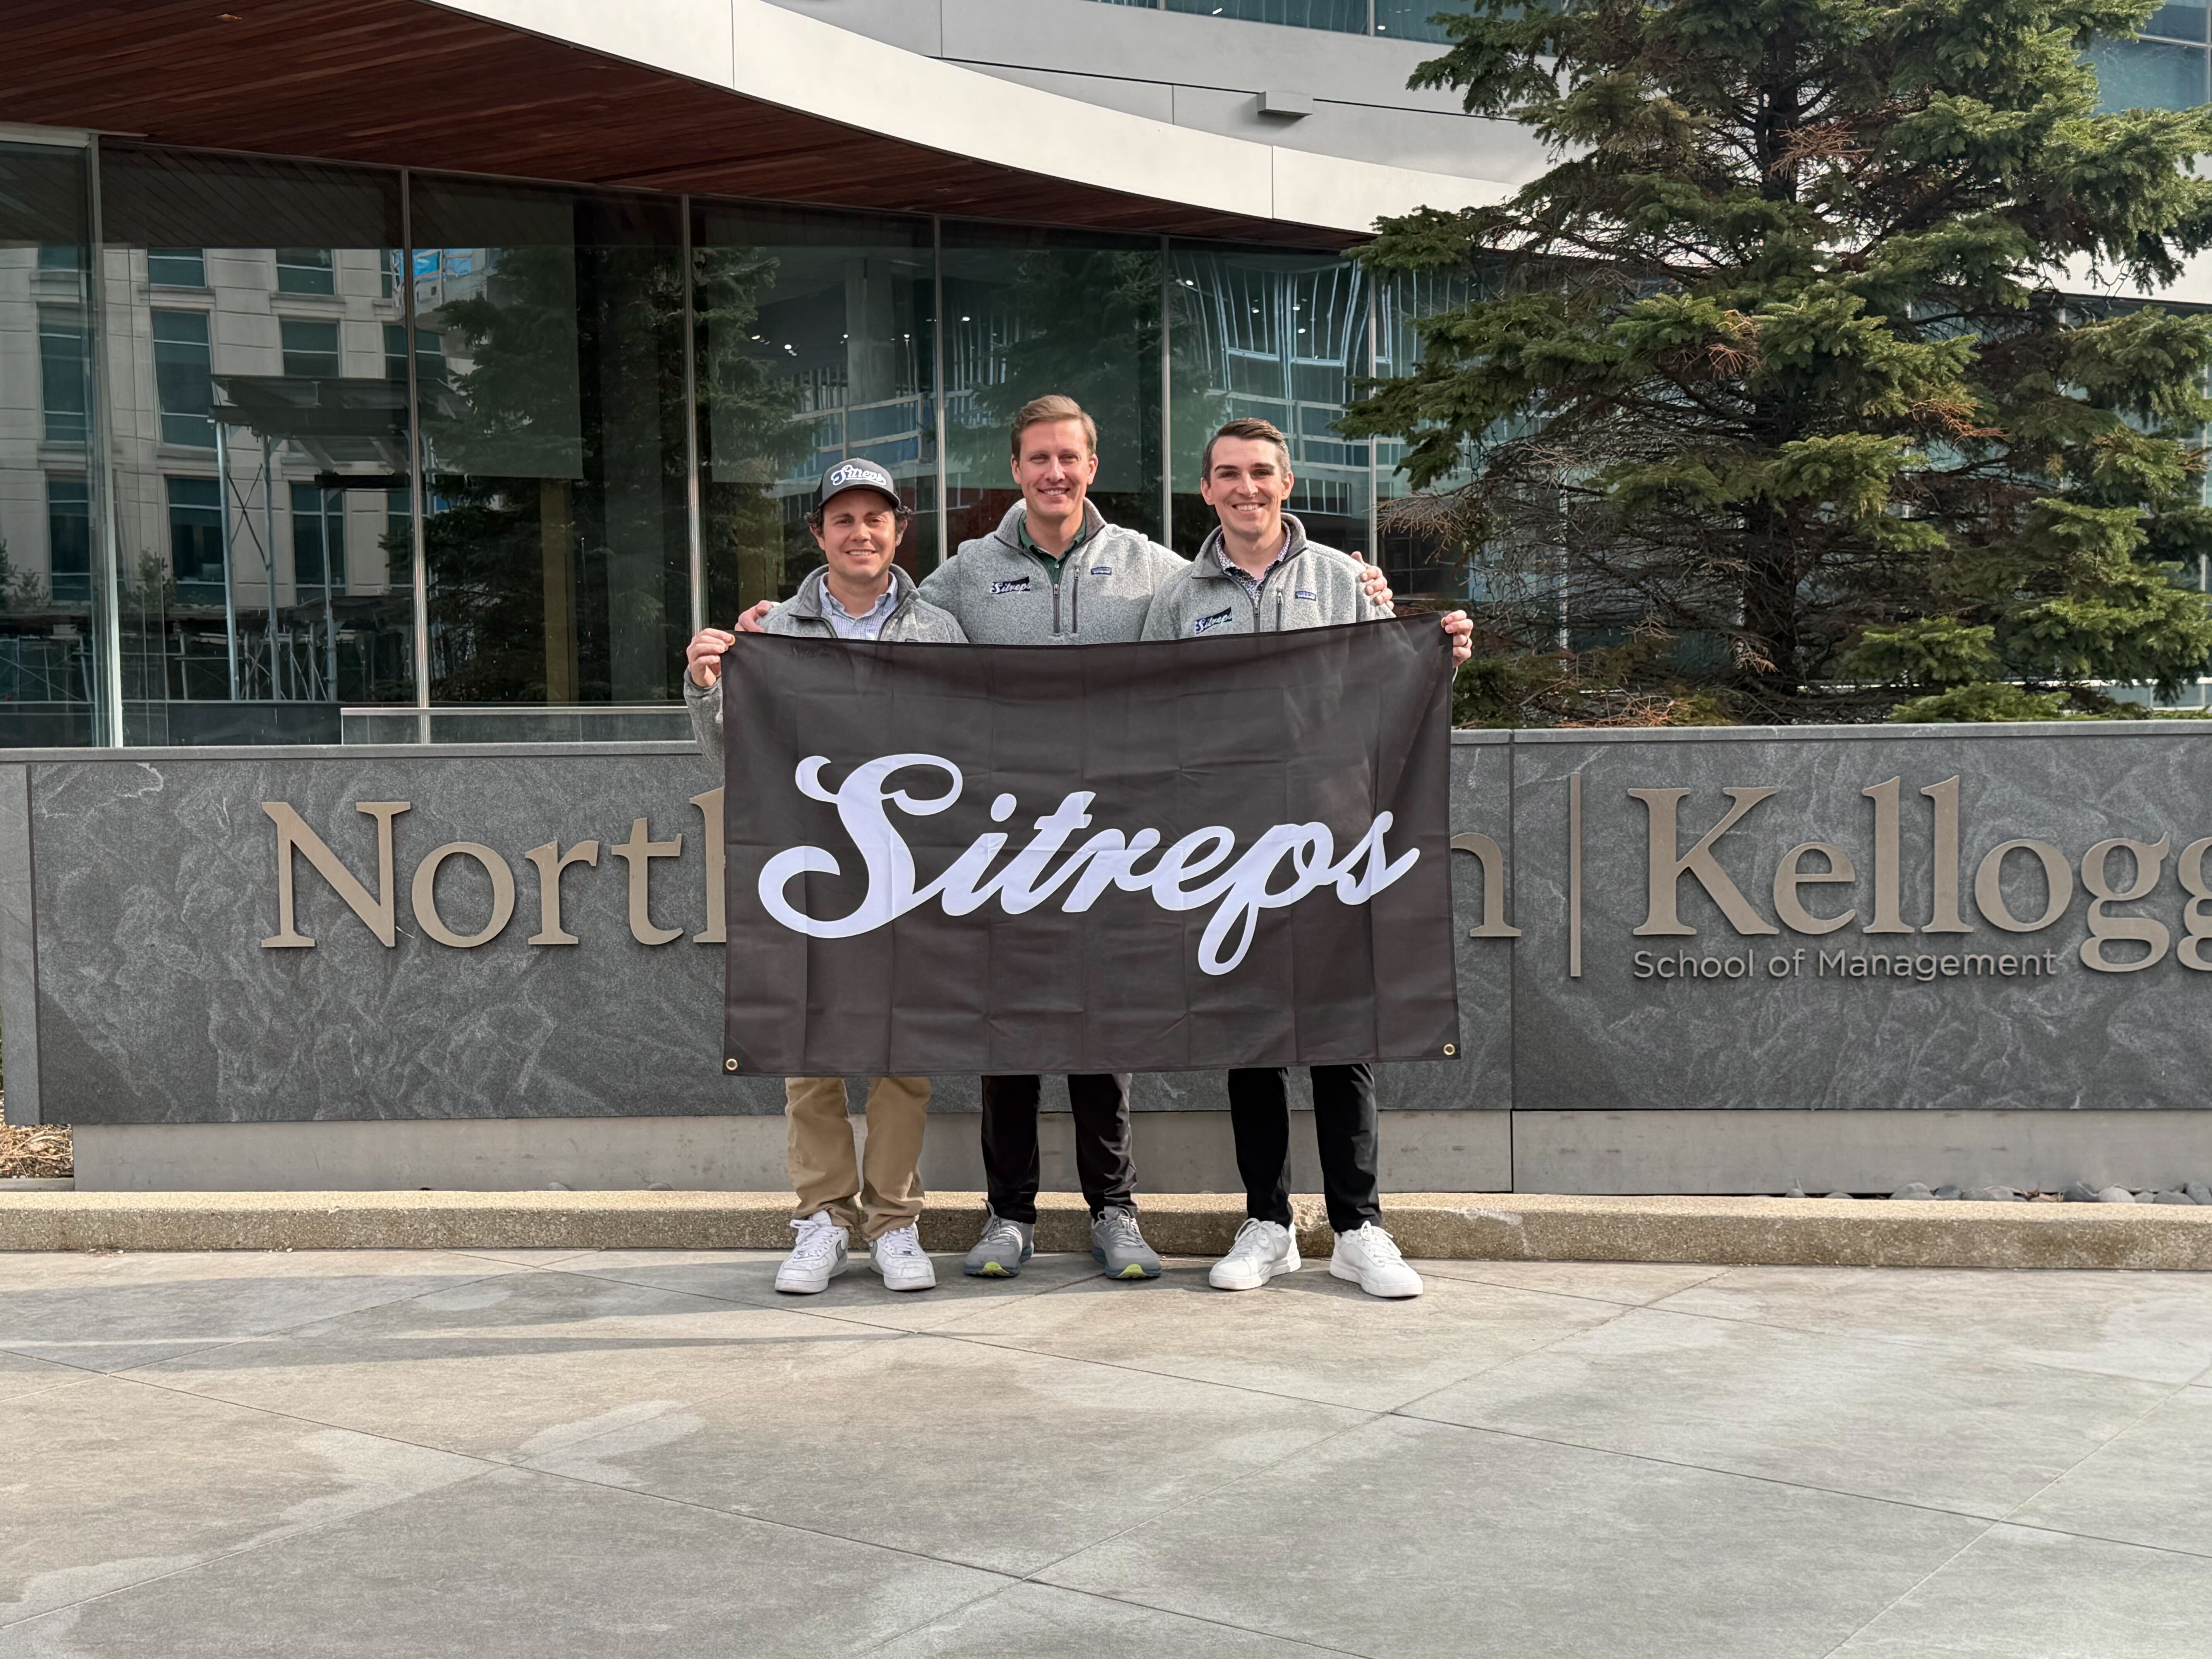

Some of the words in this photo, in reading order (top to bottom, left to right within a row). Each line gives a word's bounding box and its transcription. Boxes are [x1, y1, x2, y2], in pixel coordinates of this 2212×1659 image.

[989, 582, 1032, 594] Sitreps
[759, 753, 1420, 975] Sitreps
[1633, 949, 1753, 979] School
[1768, 949, 1805, 977] of
[1819, 948, 2057, 982] Management
